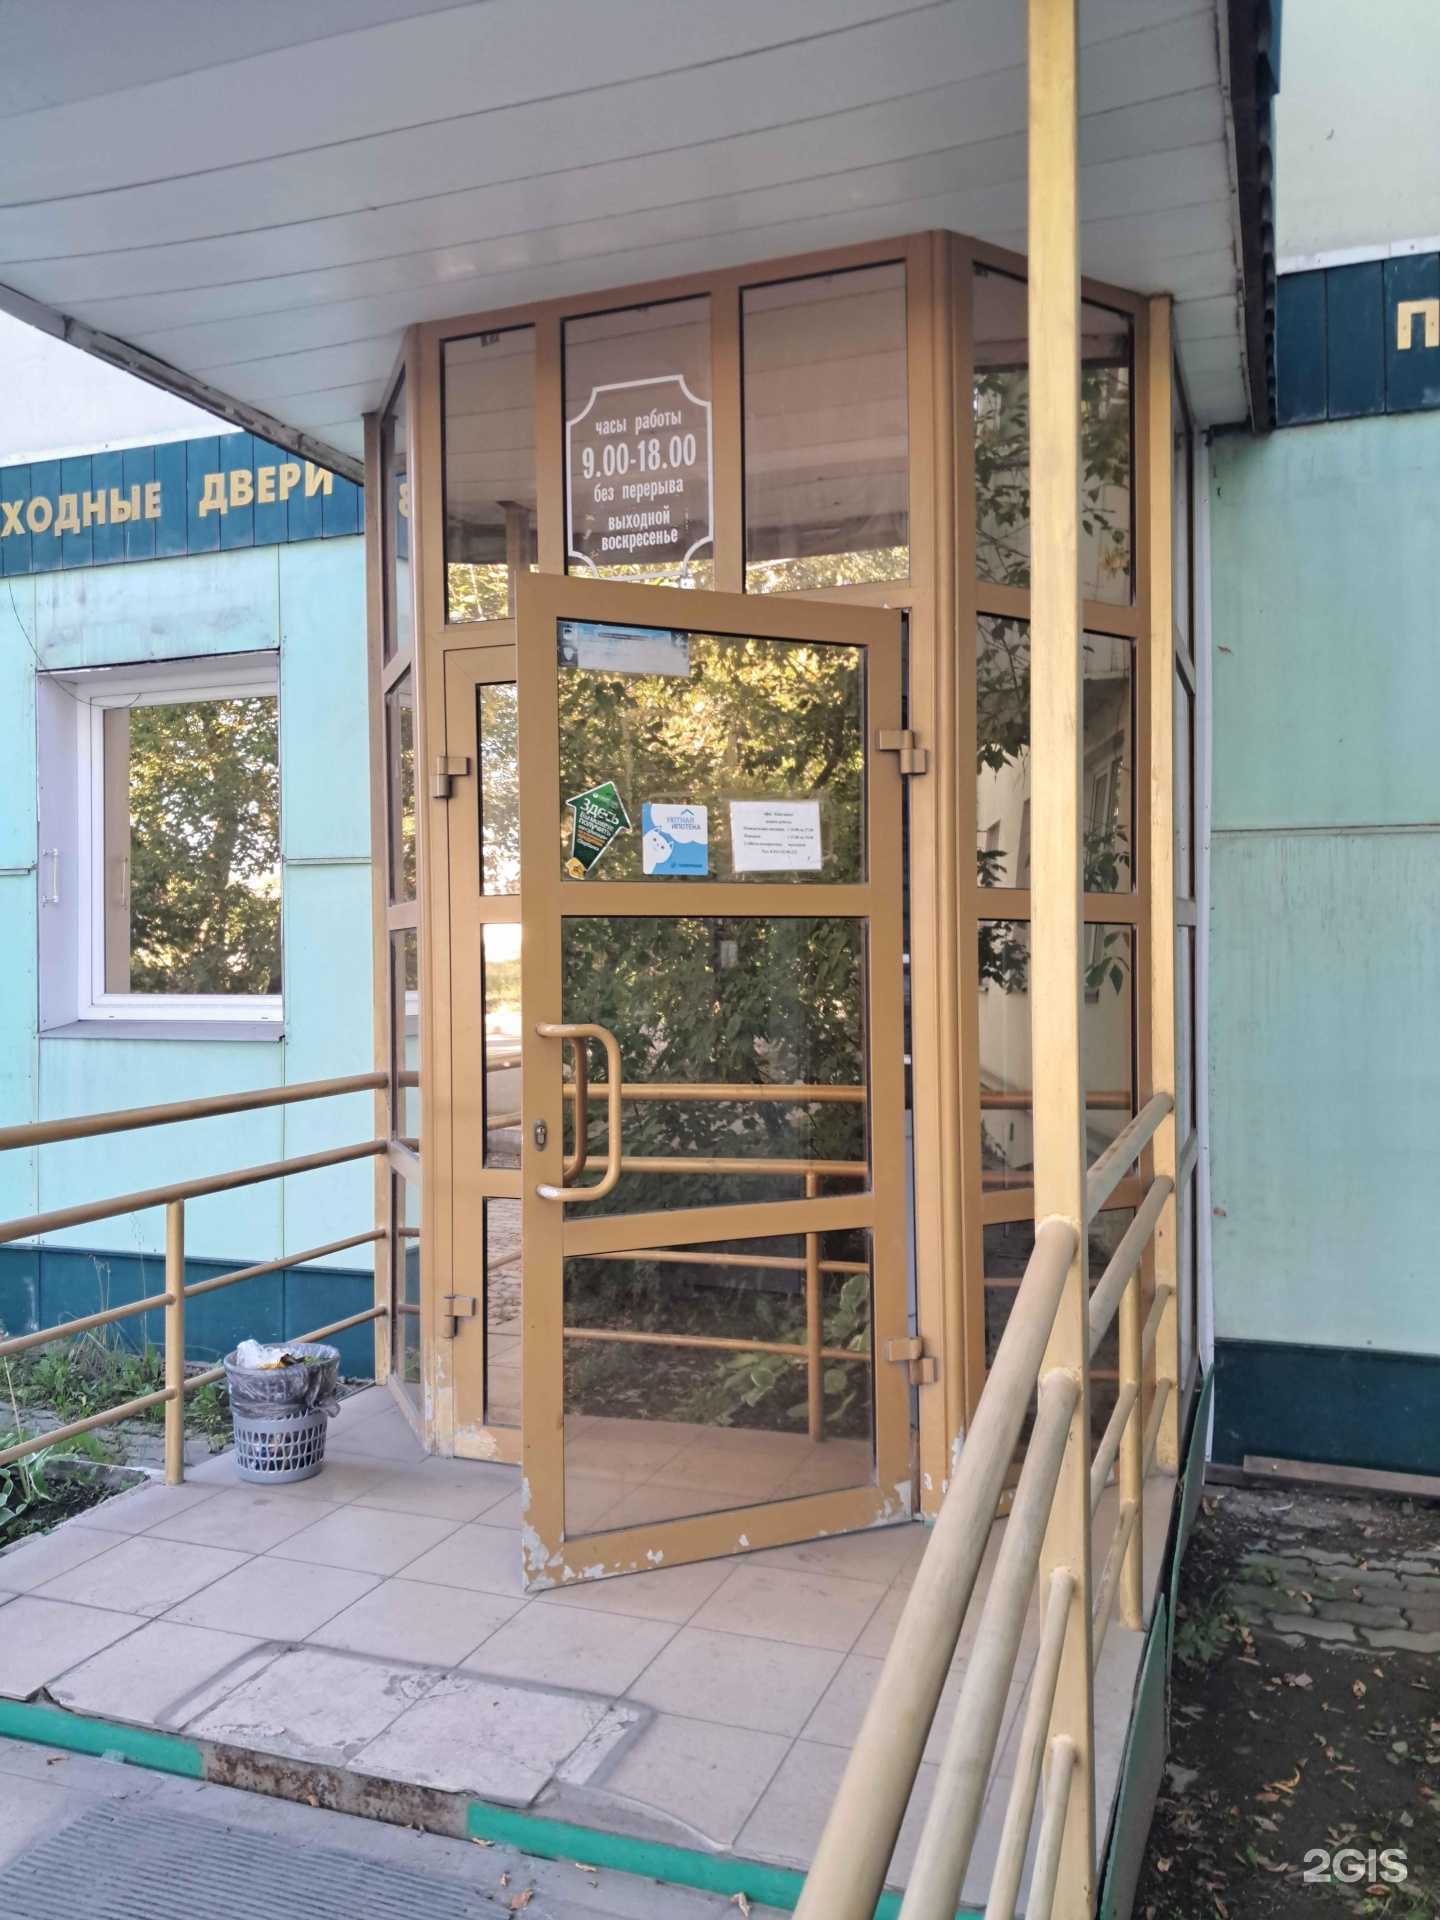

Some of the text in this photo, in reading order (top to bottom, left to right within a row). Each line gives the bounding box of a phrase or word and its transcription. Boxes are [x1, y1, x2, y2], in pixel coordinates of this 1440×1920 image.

[596, 408, 682, 436] часы работы
[582, 433, 696, 480] 9.00-18.00
[0, 482, 161, 537] ХОДНЫЕ
[198, 460, 334, 517] ДВЕРИ
[594, 478, 684, 503] без перерыва
[608, 505, 671, 531] выходной
[601, 528, 678, 552] воскресенье
